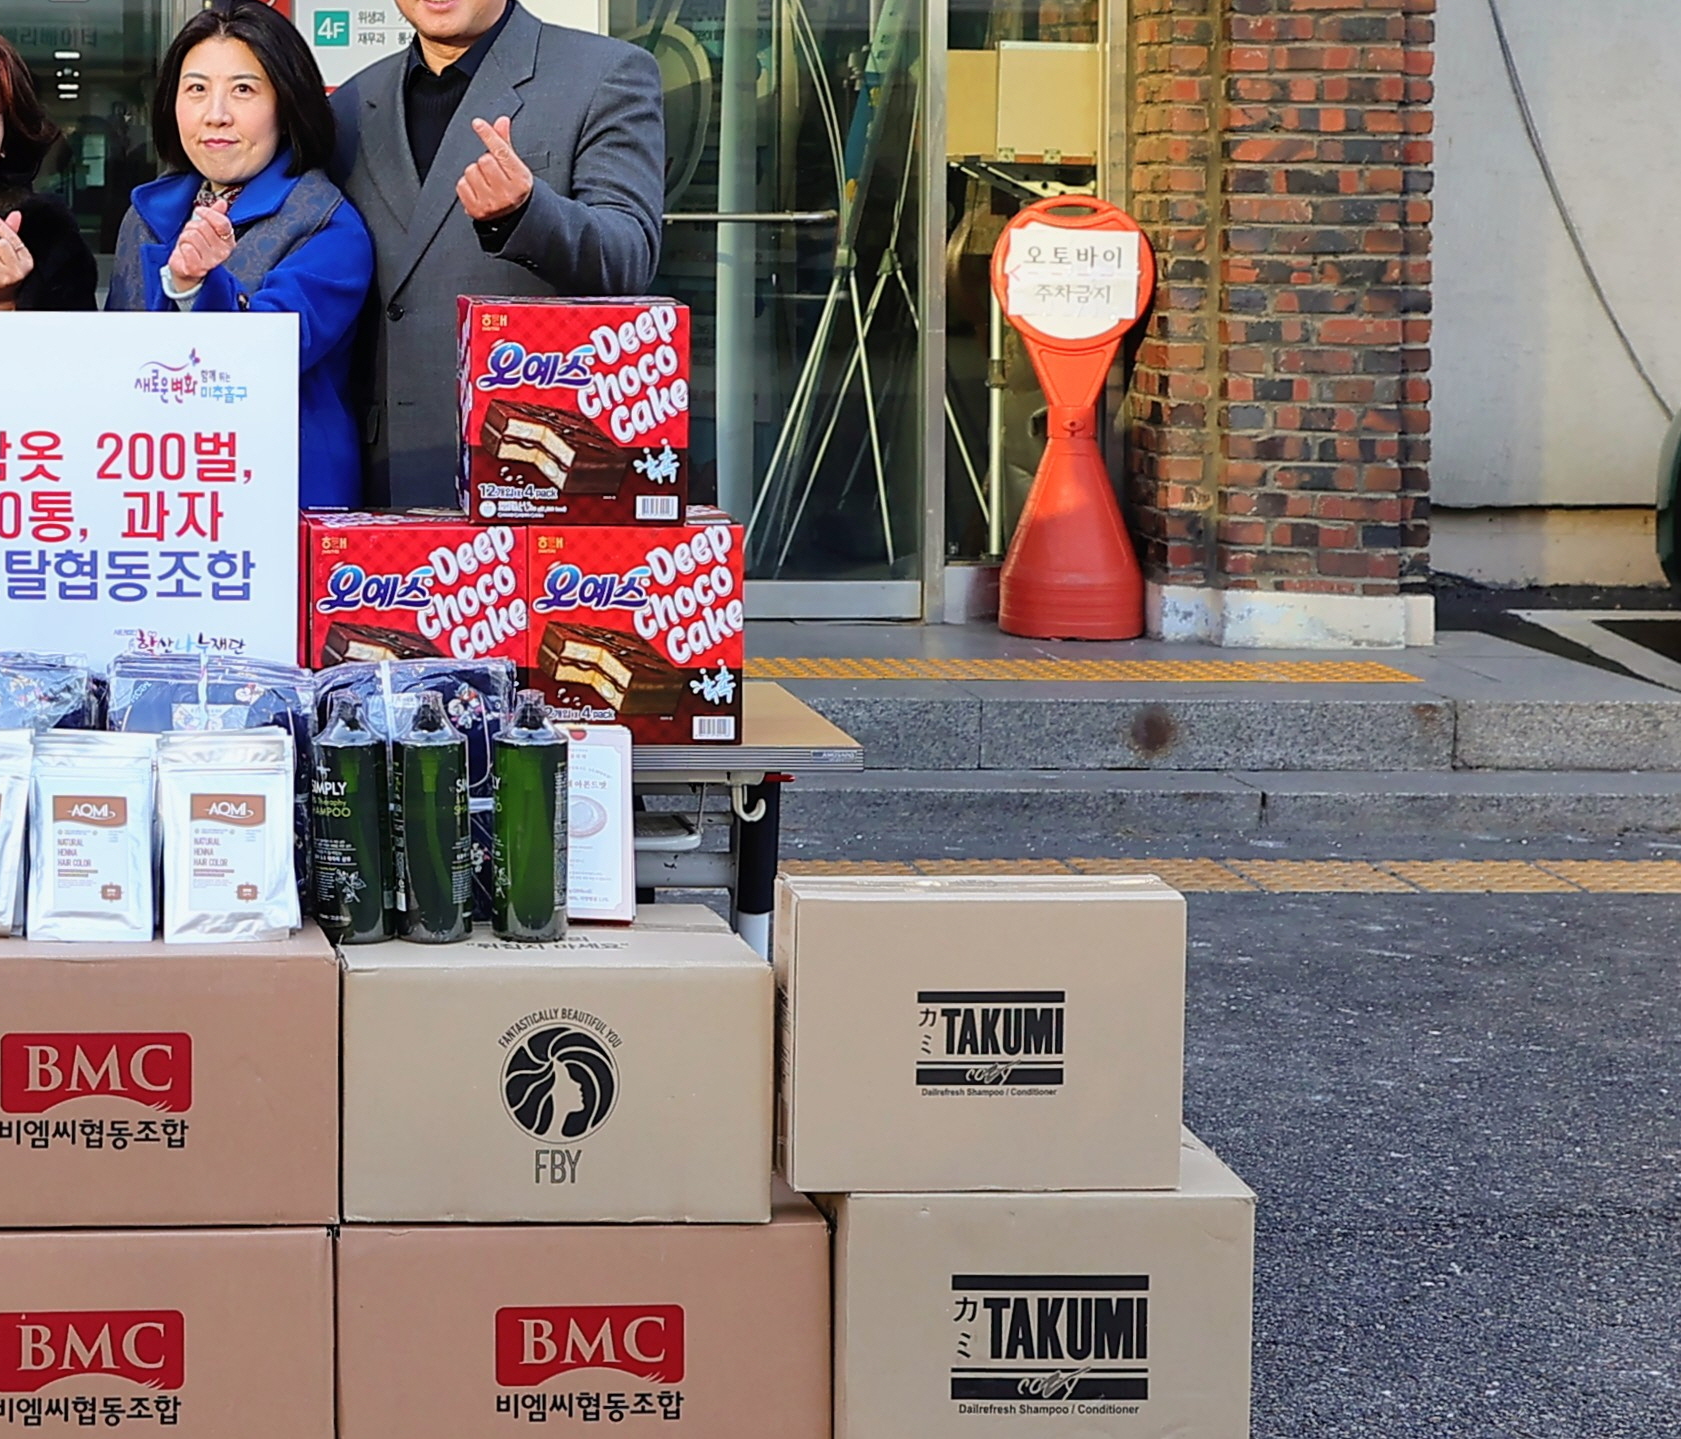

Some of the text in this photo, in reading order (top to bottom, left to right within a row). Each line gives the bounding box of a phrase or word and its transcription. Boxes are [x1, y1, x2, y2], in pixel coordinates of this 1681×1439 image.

[317, 17, 345, 39] 4F
[358, 11, 385, 24] 위생과
[358, 32, 385, 45] 재무과
[1023, 245, 1122, 269] 오토바이
[1034, 284, 1111, 304] 주차금지
[589, 306, 677, 364] Deep
[477, 340, 595, 391] 오예스
[134, 369, 198, 403] 새로운 변화
[200, 386, 247, 403] 미추홀구
[96, 430, 253, 484] 200벌,
[121, 489, 224, 543] 과자
[428, 526, 514, 586] Deep
[645, 525, 732, 586] Deep
[316, 563, 435, 614] 오예스
[533, 562, 651, 613] 오예스
[57, 838, 84, 847] NATURAL
[57, 848, 77, 856] HENNA
[193, 837, 221, 846] NATURAL
[193, 848, 214, 856] HENNA
[58, 859, 92, 867] HAIR COLOR
[193, 858, 228, 867] HAIR COLOR
[498, 1008, 623, 1048] FANTASTICALLY BEAUTIFUL YOU
[941, 1007, 1064, 1056] TAKUMI
[23, 1044, 173, 1093] BMC
[921, 1088, 965, 1096] Dailrefresh
[967, 1088, 1004, 1098] Shampoo
[1010, 1088, 1057, 1096] Conditioner
[535, 1149, 582, 1184] FBY
[518, 1317, 667, 1366] BMC
[983, 1297, 1147, 1360] TAKUMI
[16, 1322, 166, 1371] BMC
[496, 1391, 685, 1423] 비엠씨협동조합
[958, 1404, 1016, 1414] Dailrefresh
[1019, 1404, 1069, 1416] Shampoo
[1078, 1404, 1139, 1415] Conditioner
